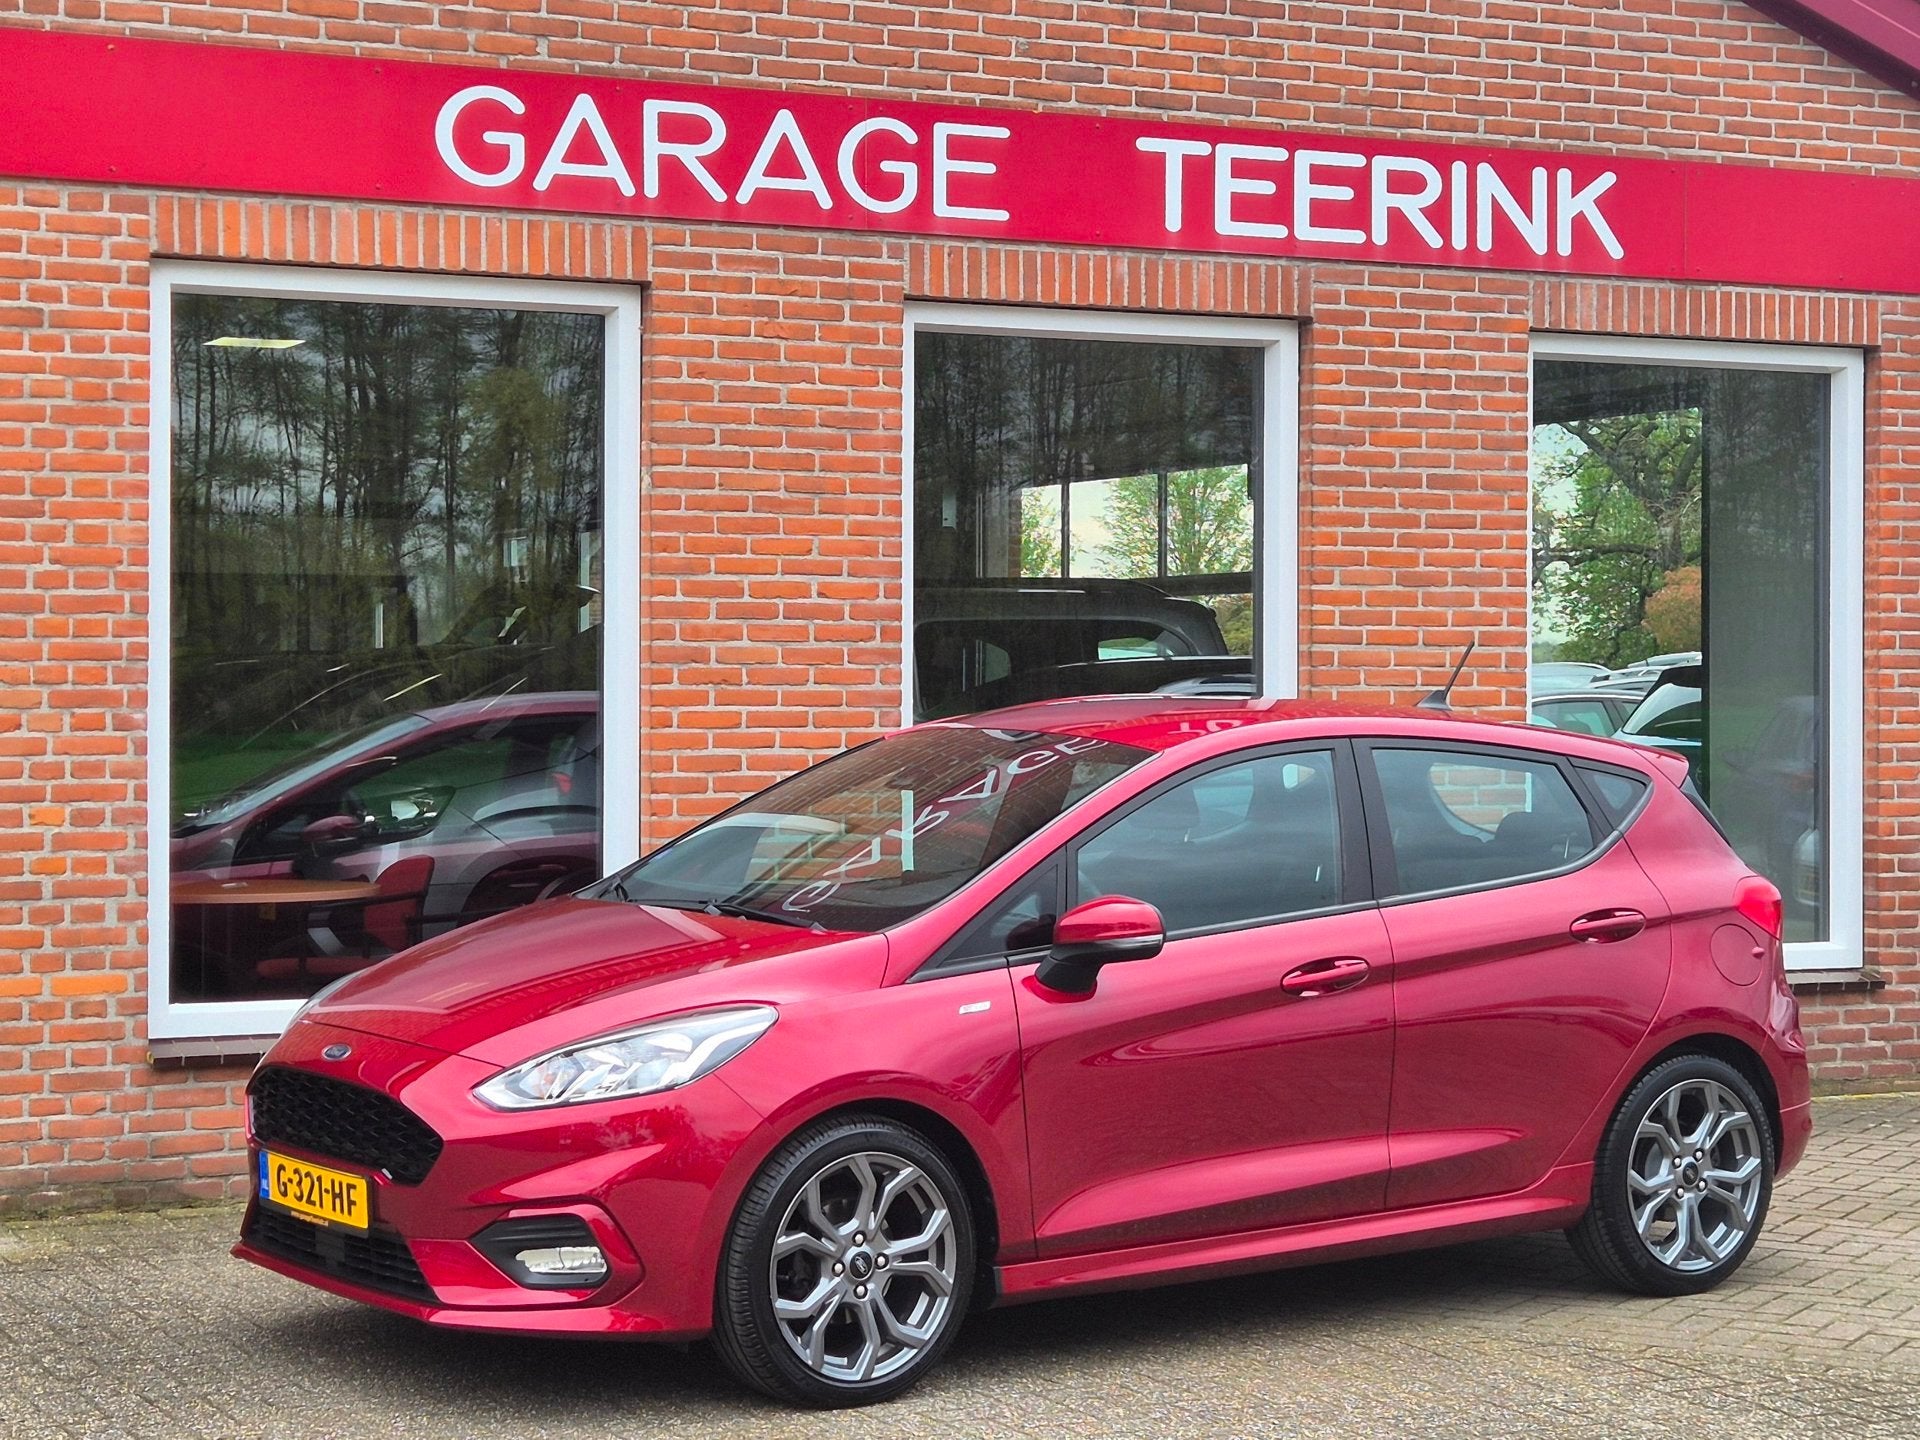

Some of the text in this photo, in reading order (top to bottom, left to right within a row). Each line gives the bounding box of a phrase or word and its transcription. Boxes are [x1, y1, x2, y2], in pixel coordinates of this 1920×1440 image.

[434, 84, 1624, 260] GARAGE TEERINK
[276, 1163, 358, 1217] G-321-HF
